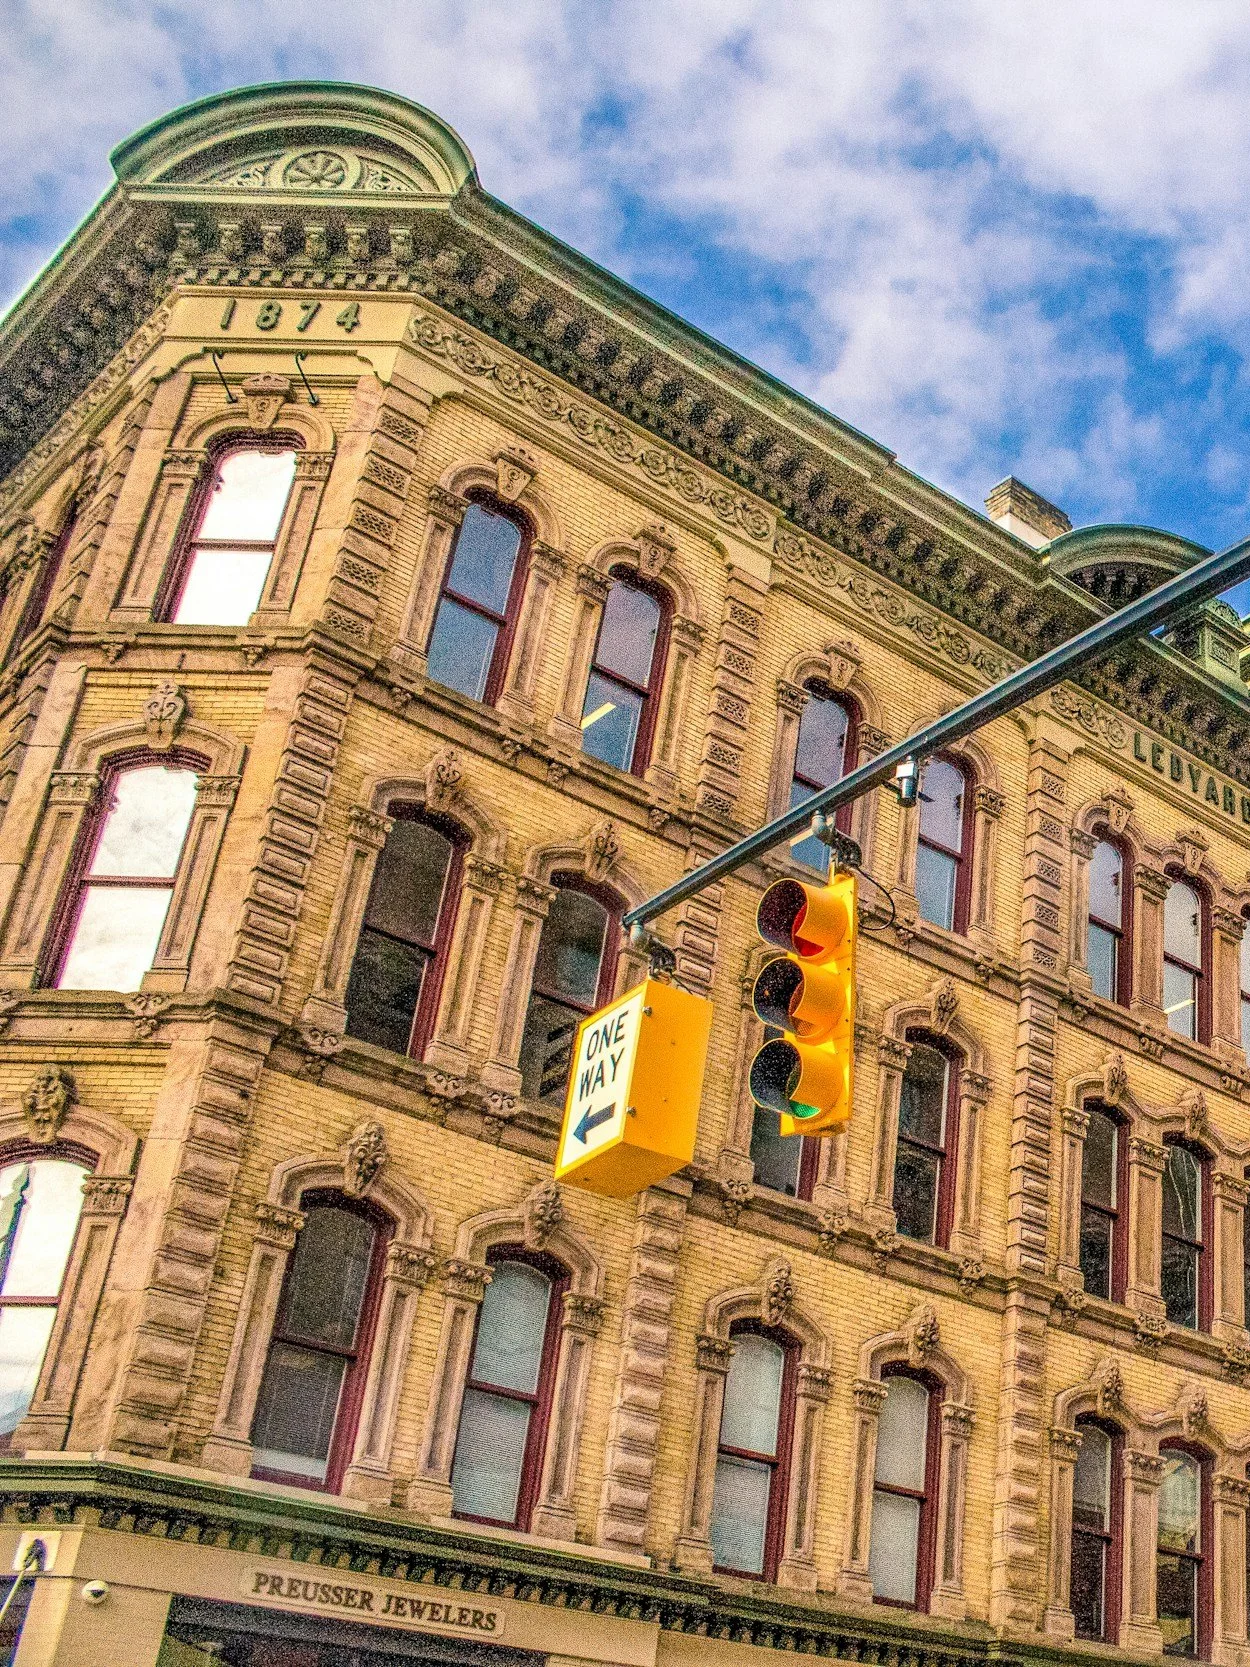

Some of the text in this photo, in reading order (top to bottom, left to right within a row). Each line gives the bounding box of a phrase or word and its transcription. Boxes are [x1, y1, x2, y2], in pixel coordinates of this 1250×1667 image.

[220, 298, 361, 333] 1874
[586, 1009, 629, 1061] ONE
[579, 1047, 625, 1102] WAY
[251, 1572, 497, 1631] PREUSSER JEWELERS
